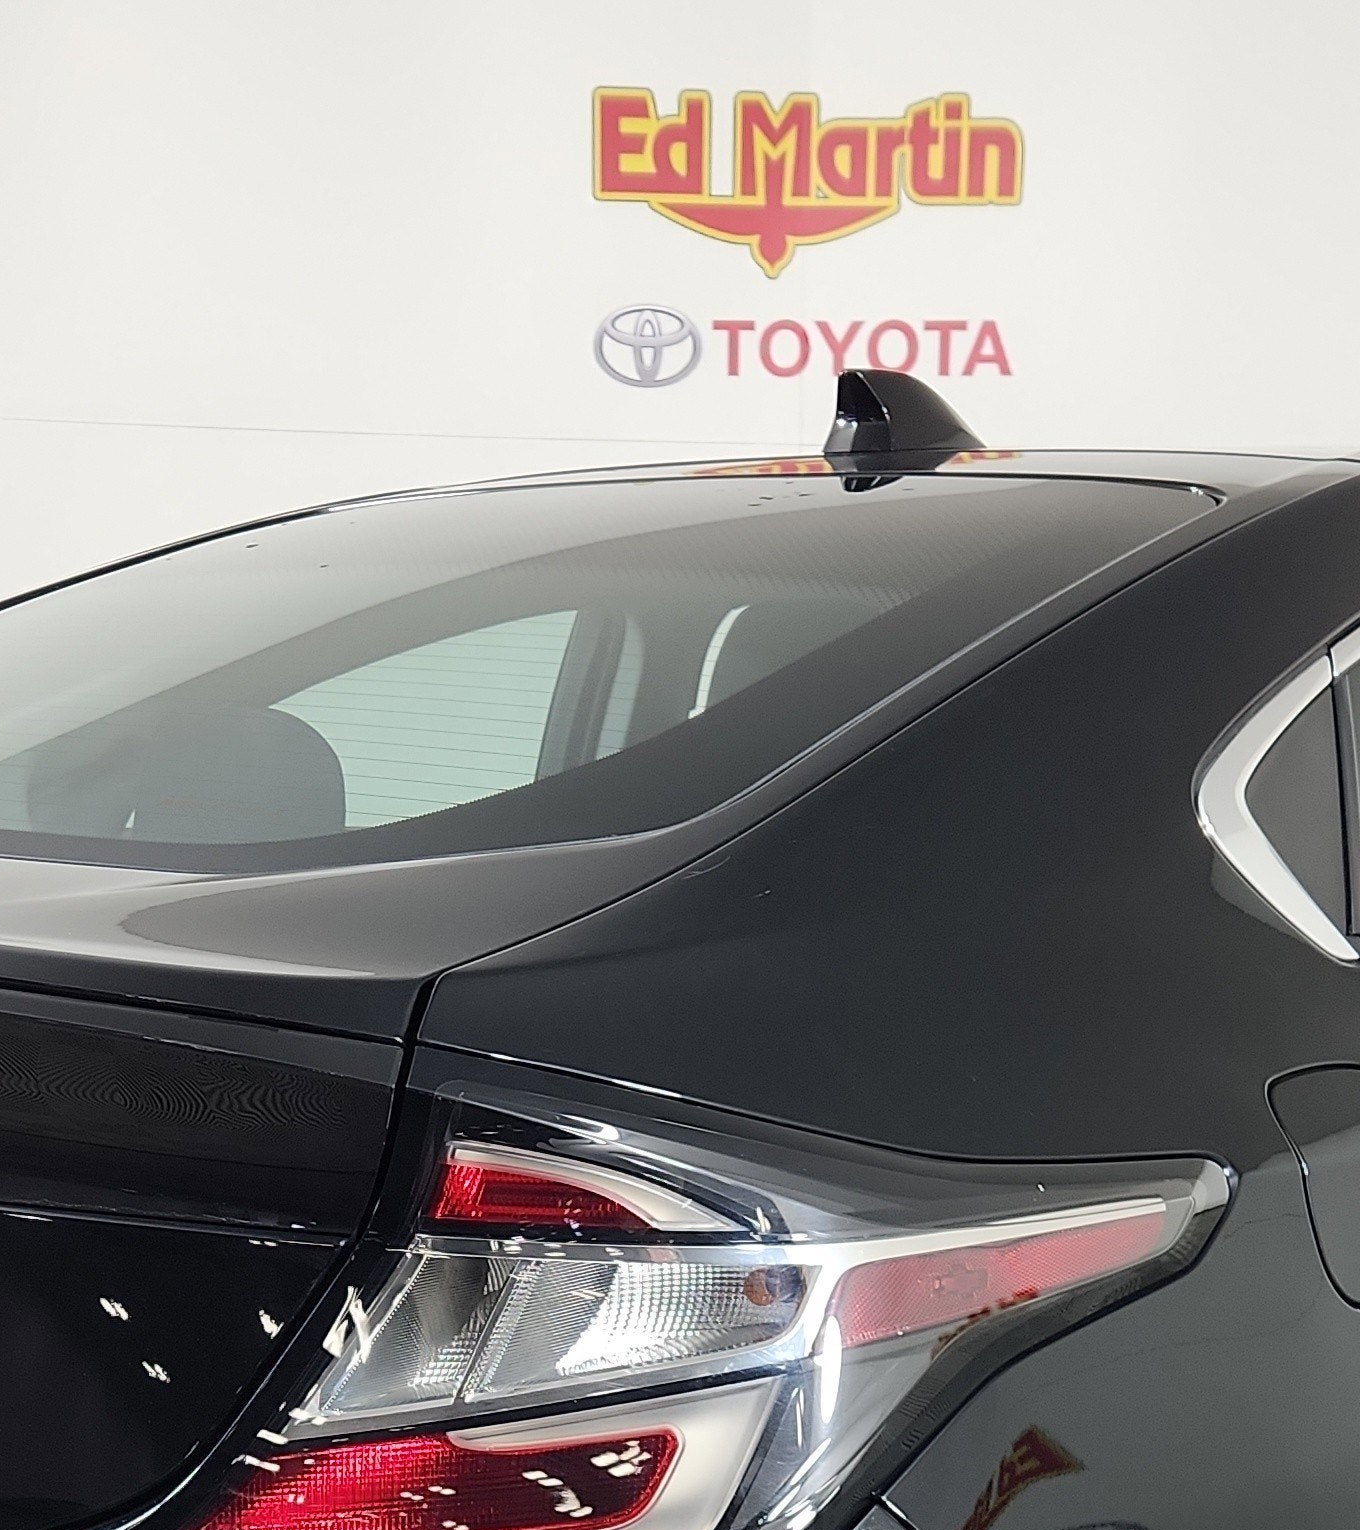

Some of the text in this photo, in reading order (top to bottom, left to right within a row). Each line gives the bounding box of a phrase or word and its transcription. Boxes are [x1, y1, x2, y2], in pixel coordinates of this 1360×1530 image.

[596, 90, 1020, 202] Ed Martin
[713, 320, 1013, 377] TOYOTA
